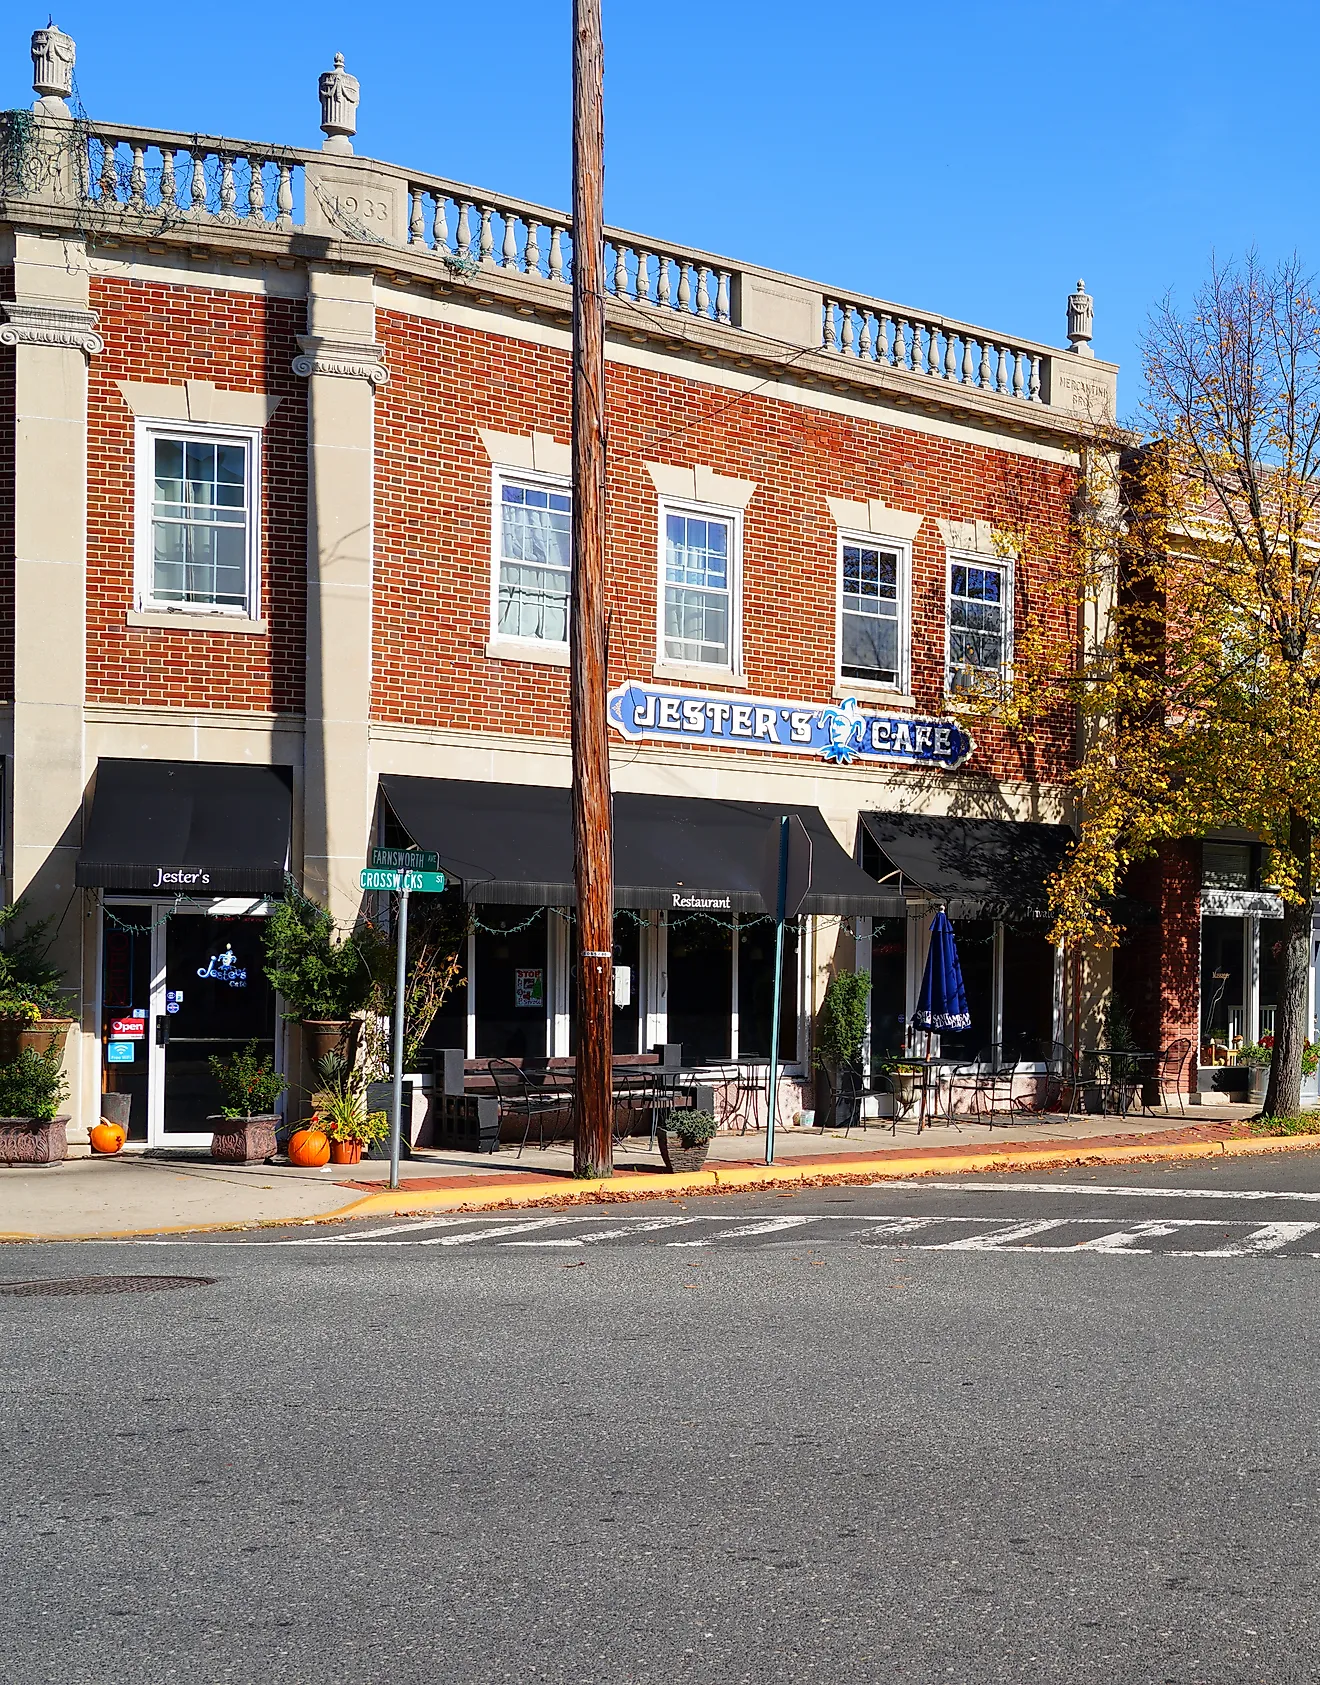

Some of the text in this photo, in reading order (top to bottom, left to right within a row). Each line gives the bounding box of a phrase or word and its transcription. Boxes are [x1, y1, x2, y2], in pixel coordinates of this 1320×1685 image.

[332, 195, 388, 221] 1933
[633, 695, 952, 755] JESTER'S CAFE
[373, 850, 437, 868] FARNSWORTH AVE
[153, 868, 210, 887] Jester's
[360, 872, 444, 889] CROSSWCKS ST
[671, 893, 731, 909] Restaurant
[517, 970, 541, 978] STOP
[112, 1021, 144, 1033] Open
